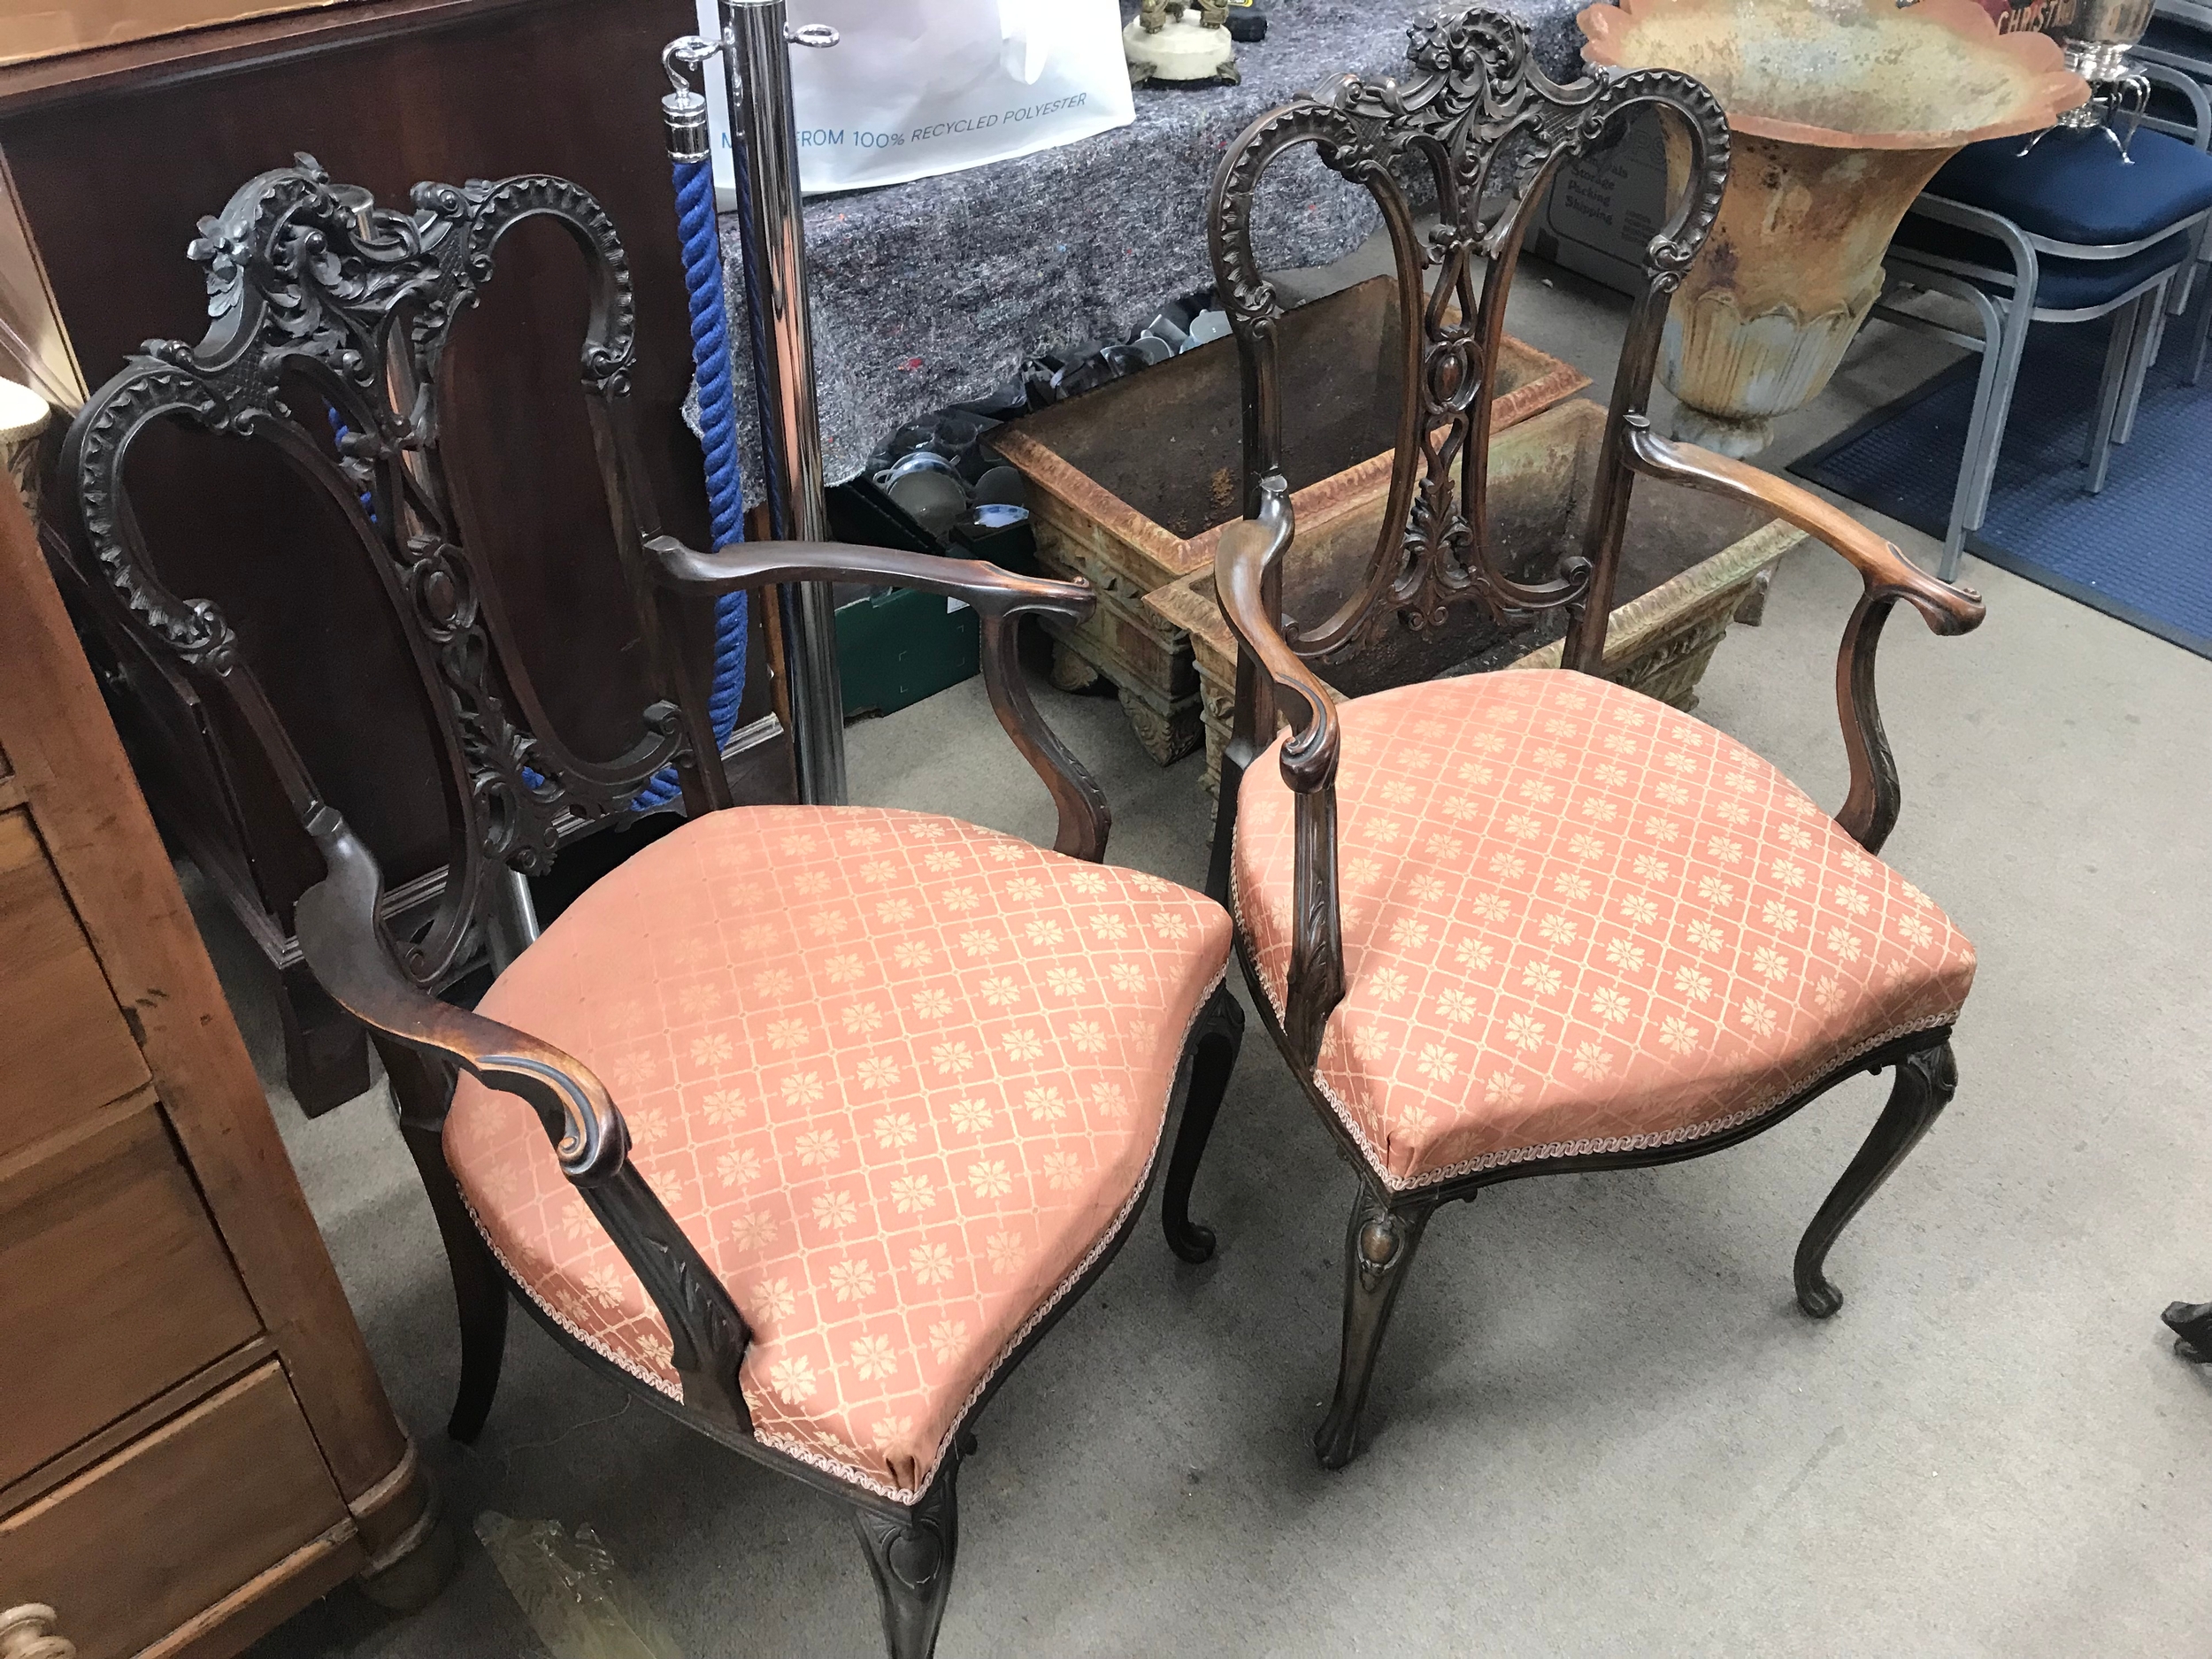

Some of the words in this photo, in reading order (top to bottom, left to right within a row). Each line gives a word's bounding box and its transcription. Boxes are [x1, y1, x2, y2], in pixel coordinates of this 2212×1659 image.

[853, 131, 905, 149] 100%
[910, 114, 998, 142] RECYCLED
[1002, 92, 1087, 125] POLYESTER
[1568, 180, 1611, 207] Packing
[1564, 195, 1613, 227] Shipping
